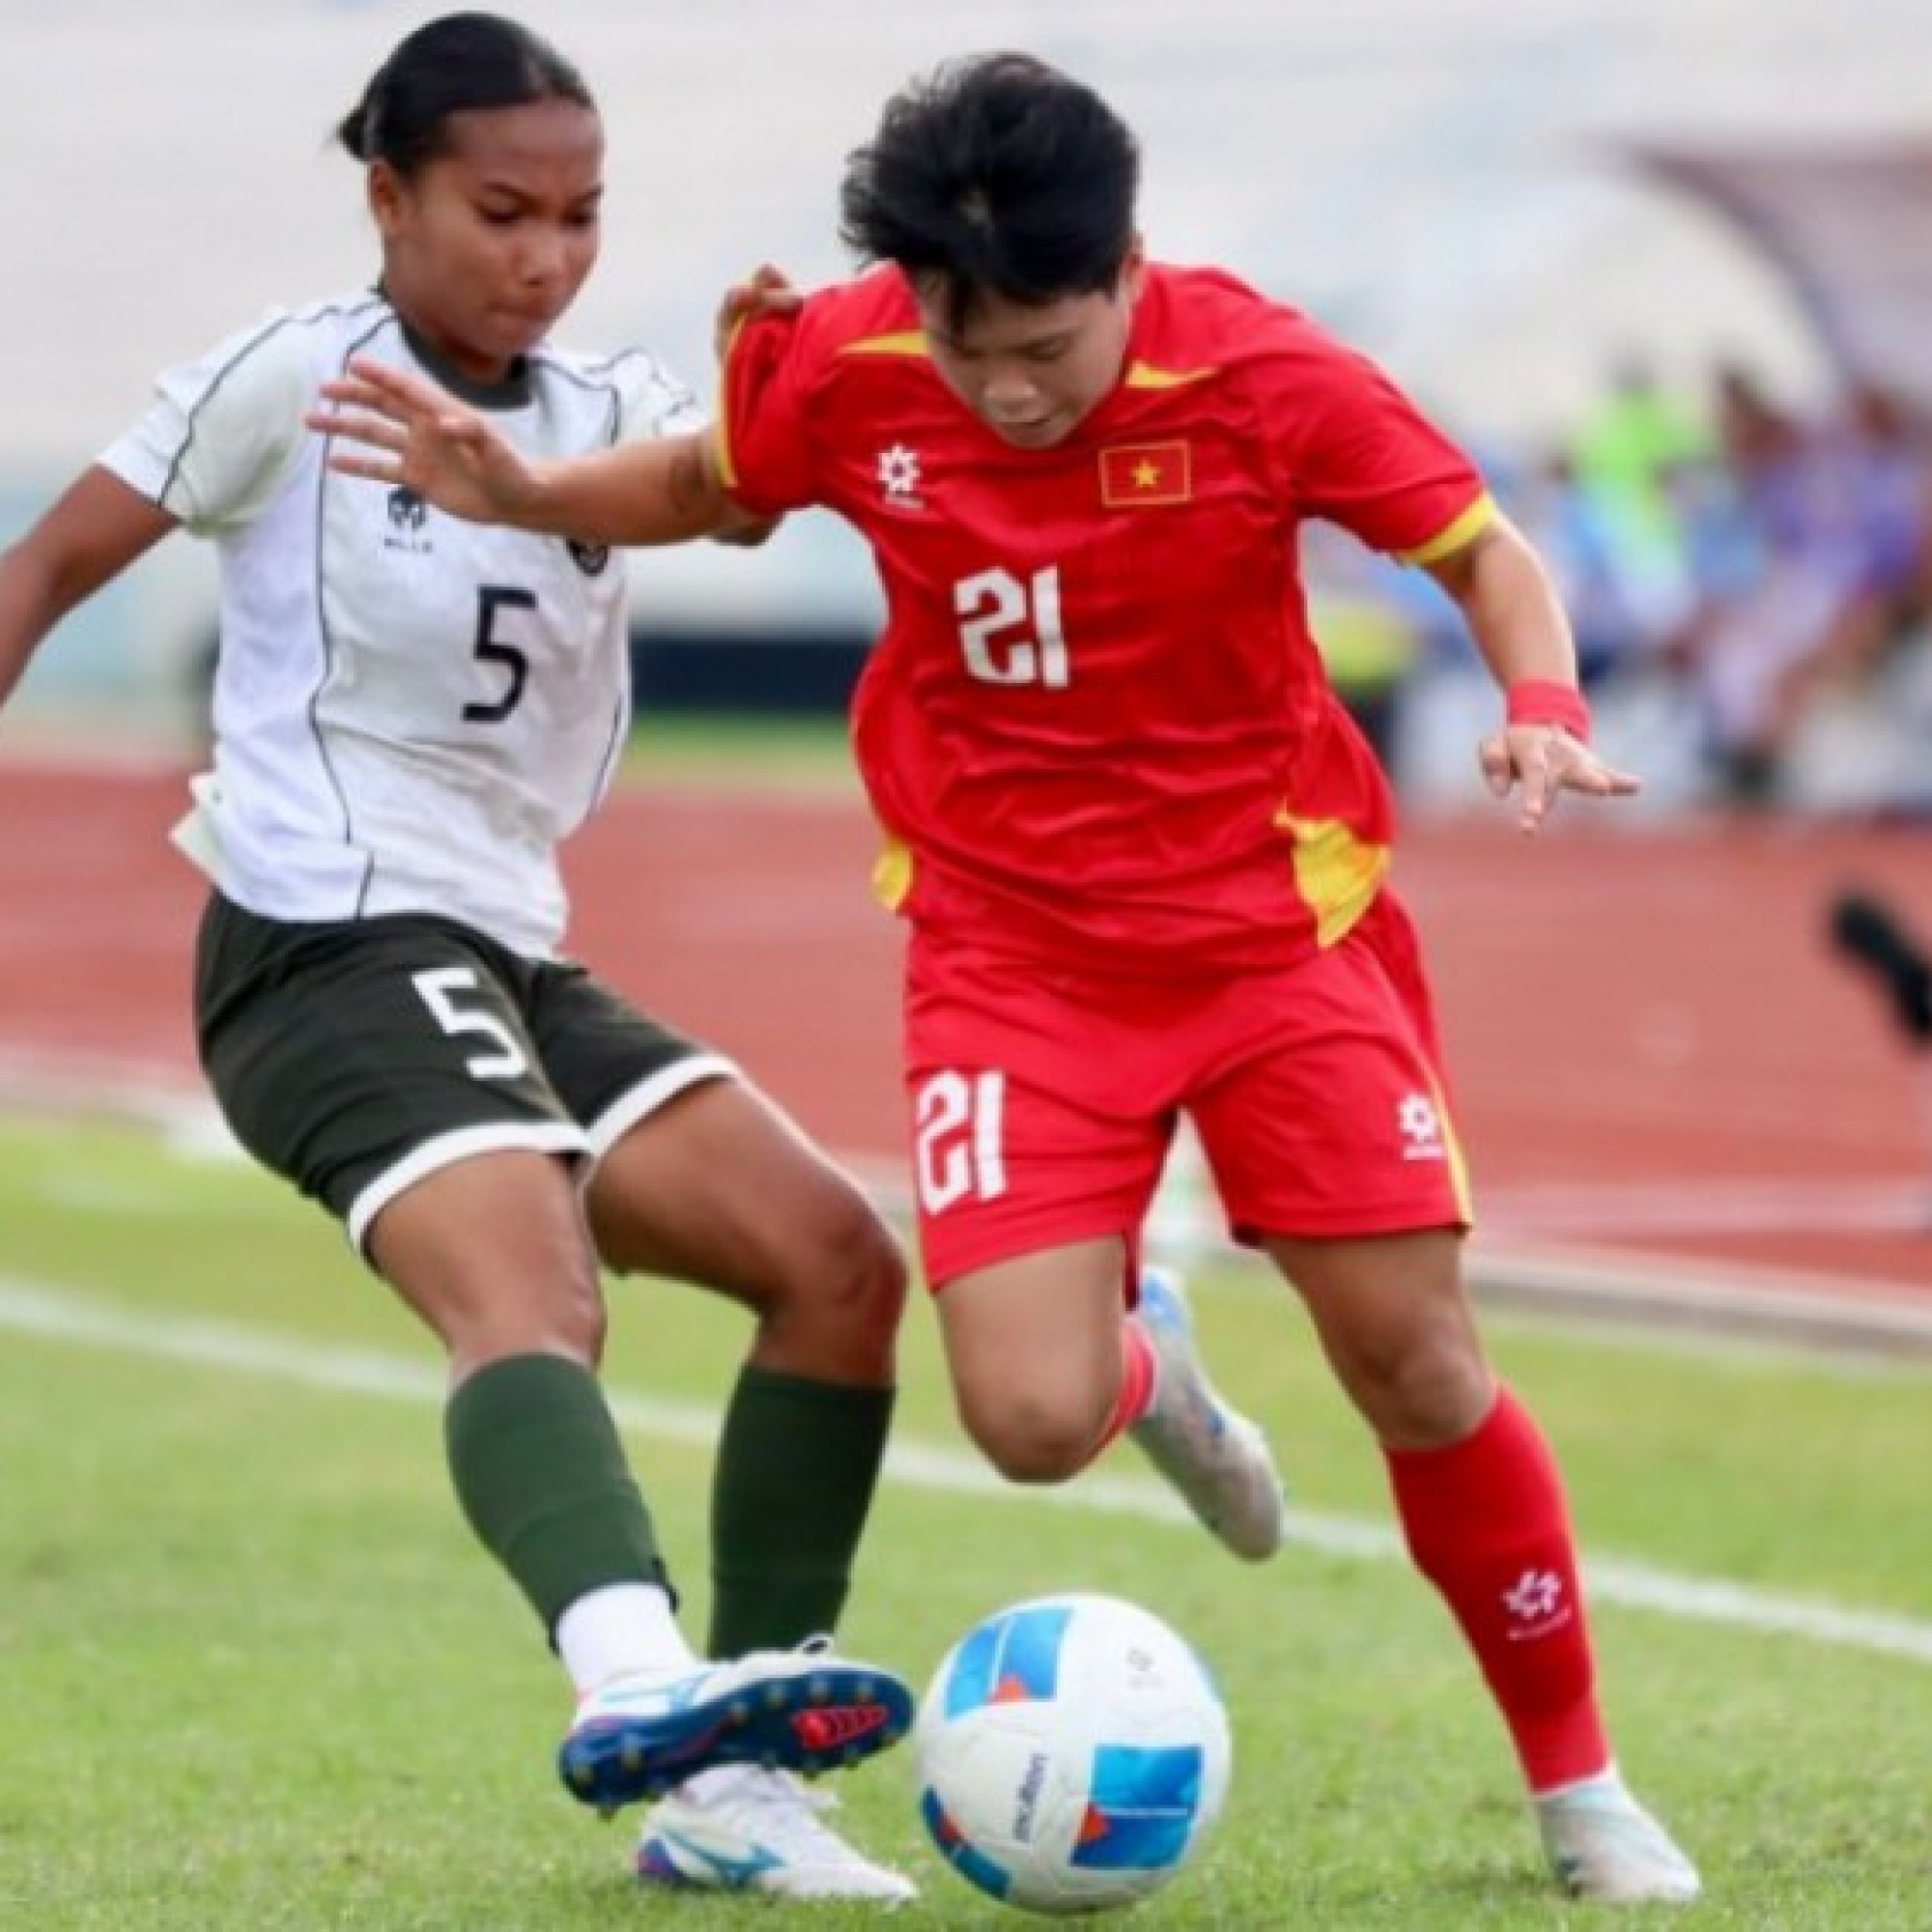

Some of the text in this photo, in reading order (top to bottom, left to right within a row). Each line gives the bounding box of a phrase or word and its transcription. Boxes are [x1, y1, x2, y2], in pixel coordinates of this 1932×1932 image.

[462, 585, 538, 722] 5
[954, 565, 1068, 690] 21
[412, 967, 528, 1080] 5
[917, 1069, 1007, 1215] 21
